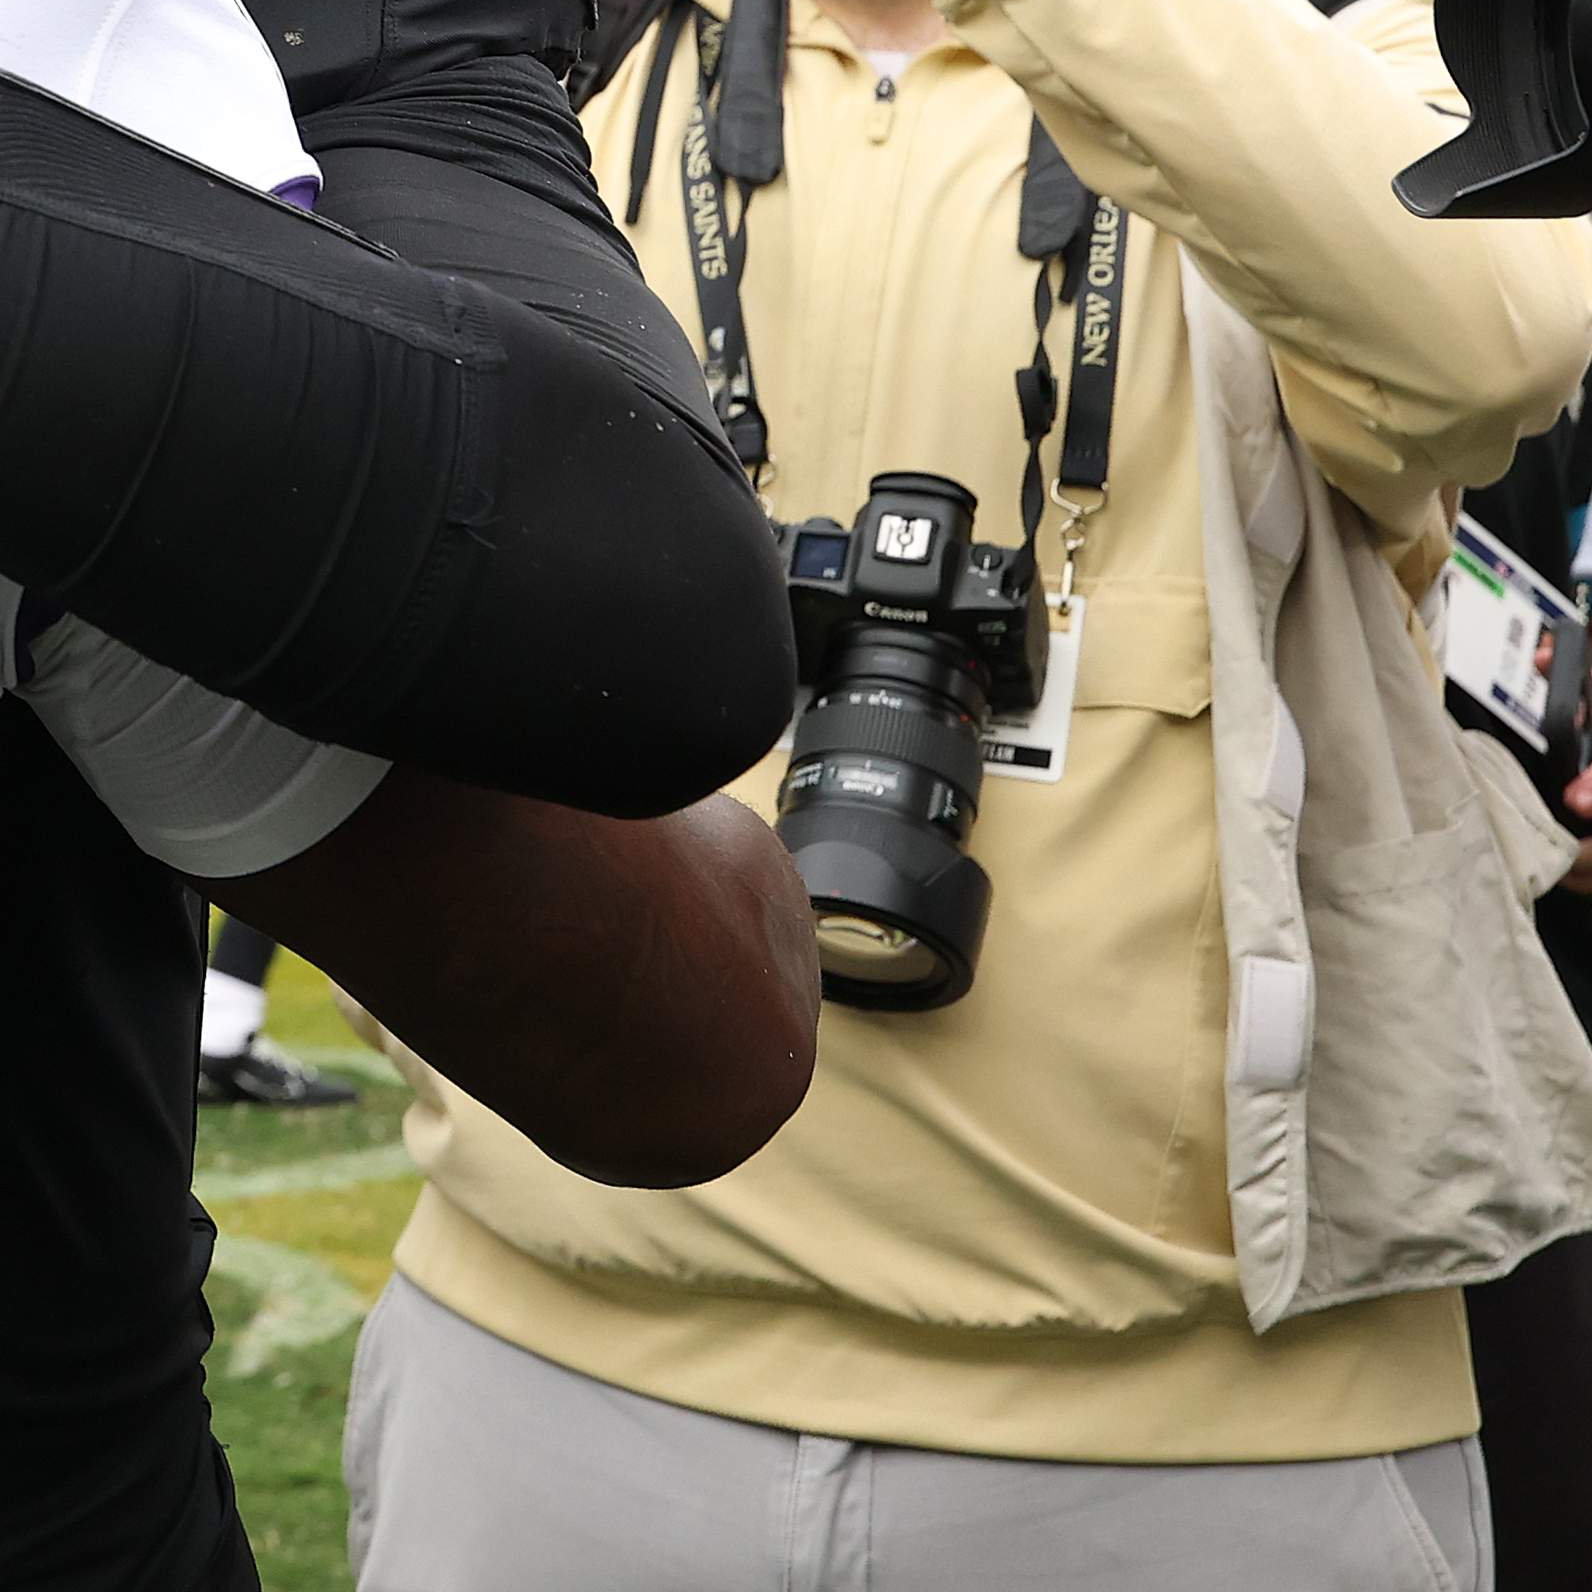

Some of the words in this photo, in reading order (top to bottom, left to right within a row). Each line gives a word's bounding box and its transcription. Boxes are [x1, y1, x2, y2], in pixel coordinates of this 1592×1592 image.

[688, 182, 727, 280] SAINTS
[1080, 293, 1112, 367] NEW
[863, 601, 929, 623] Canon
